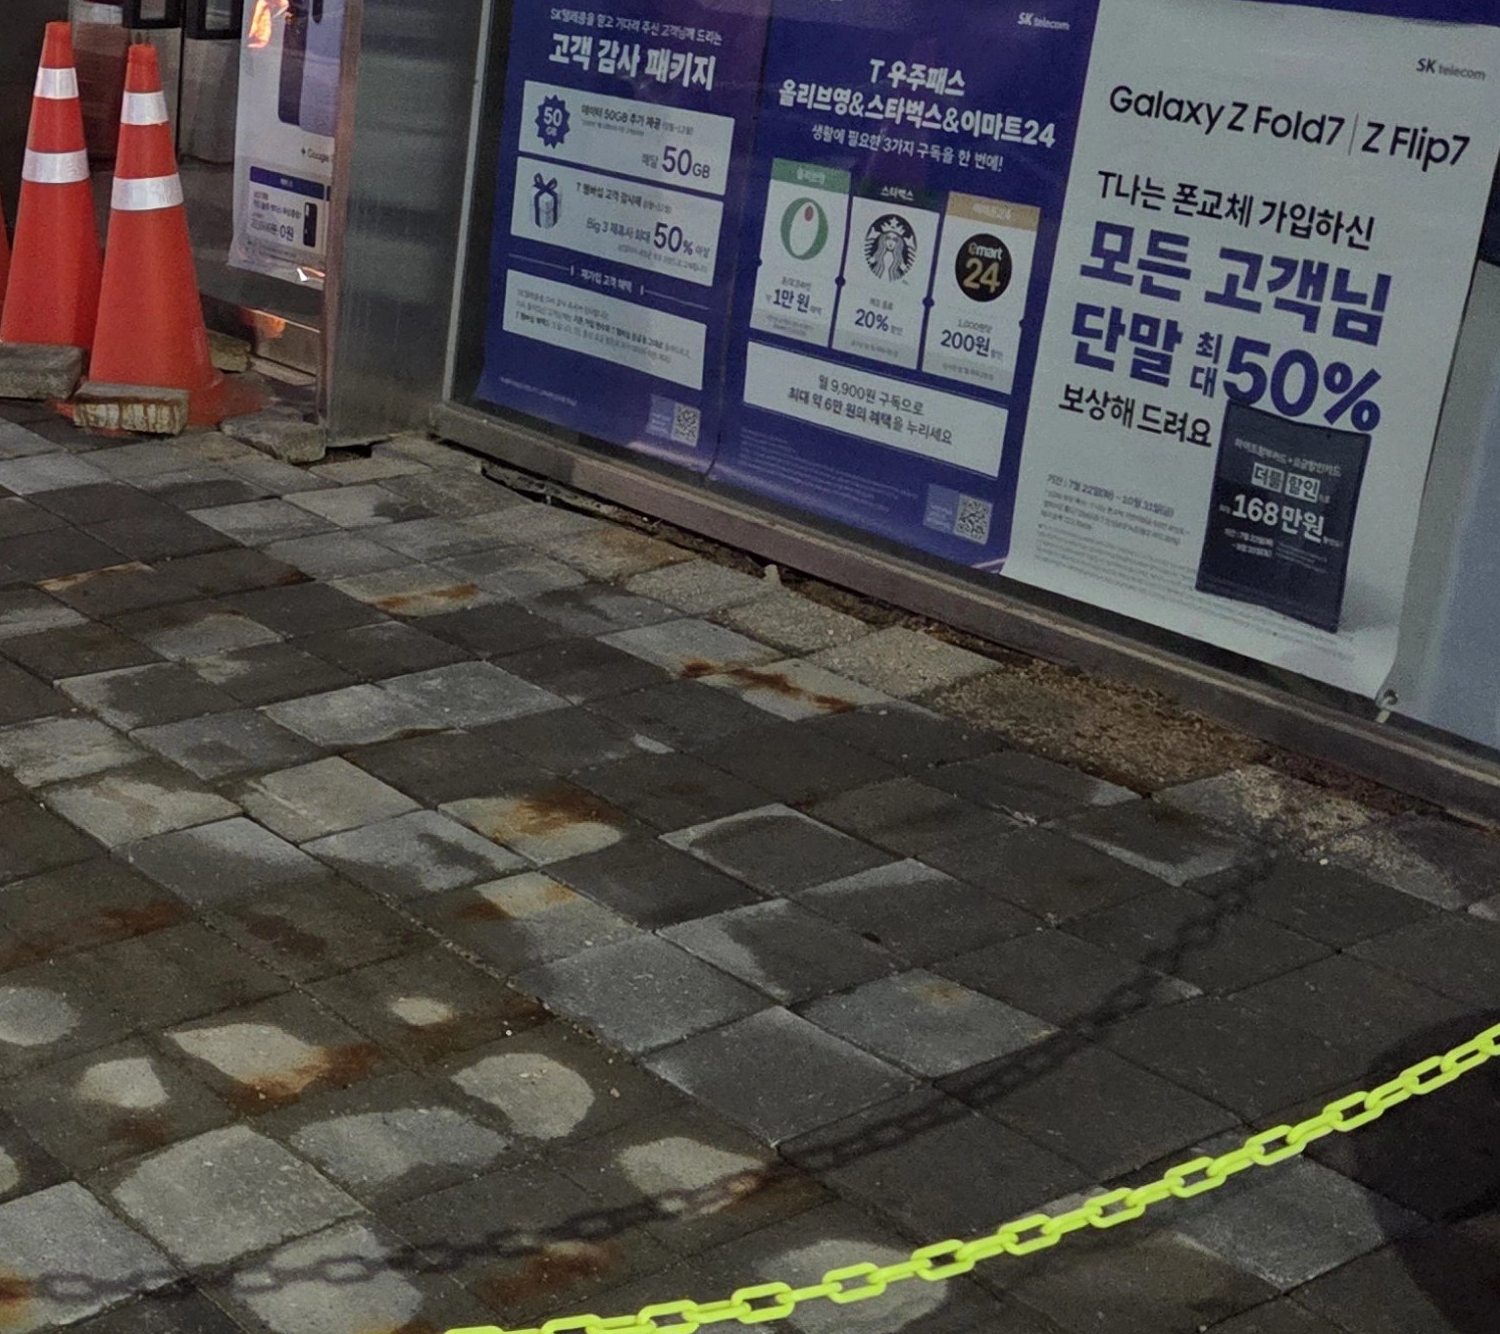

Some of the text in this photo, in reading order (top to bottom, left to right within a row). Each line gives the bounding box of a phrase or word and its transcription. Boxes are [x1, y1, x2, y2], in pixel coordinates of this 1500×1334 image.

[1017, 11, 1071, 31] SK telecom
[549, 33, 717, 92] 고객 감사 패키지
[869, 58, 966, 97] T 우주패스
[1415, 58, 1487, 82] SK telecom
[543, 108, 563, 127] 50
[779, 79, 1058, 149] 올리브영&스타벅스&이마트24
[1109, 85, 1471, 172] Galaxy Z Fold7 Z Flip7
[662, 145, 710, 179] 50GB
[811, 124, 1005, 174] 생활에 필요한 3가지 구독을 한 번에!
[1098, 171, 1376, 253] T나는 폰교체 가입하신
[653, 221, 694, 256] 50%
[967, 241, 1004, 262] emart
[963, 258, 1001, 294] 24
[1080, 220, 1393, 348] 모든 고객님
[772, 288, 796, 310] 1만
[796, 293, 811, 314] 원
[854, 308, 889, 332] 20%
[940, 328, 990, 358] 200원
[1071, 302, 1383, 432] 단말 최대 50%
[818, 374, 924, 416] 월 9,900원 구독으로
[788, 386, 810, 404] 최대
[824, 398, 844, 415] 6만
[845, 402, 868, 423] 원의
[869, 411, 905, 433] 혜택을
[906, 419, 955, 446] 누리세요
[1058, 383, 1213, 448] 보상해 드려요
[1252, 464, 1319, 502] 더블 할인
[1232, 493, 1325, 544] 168만원
